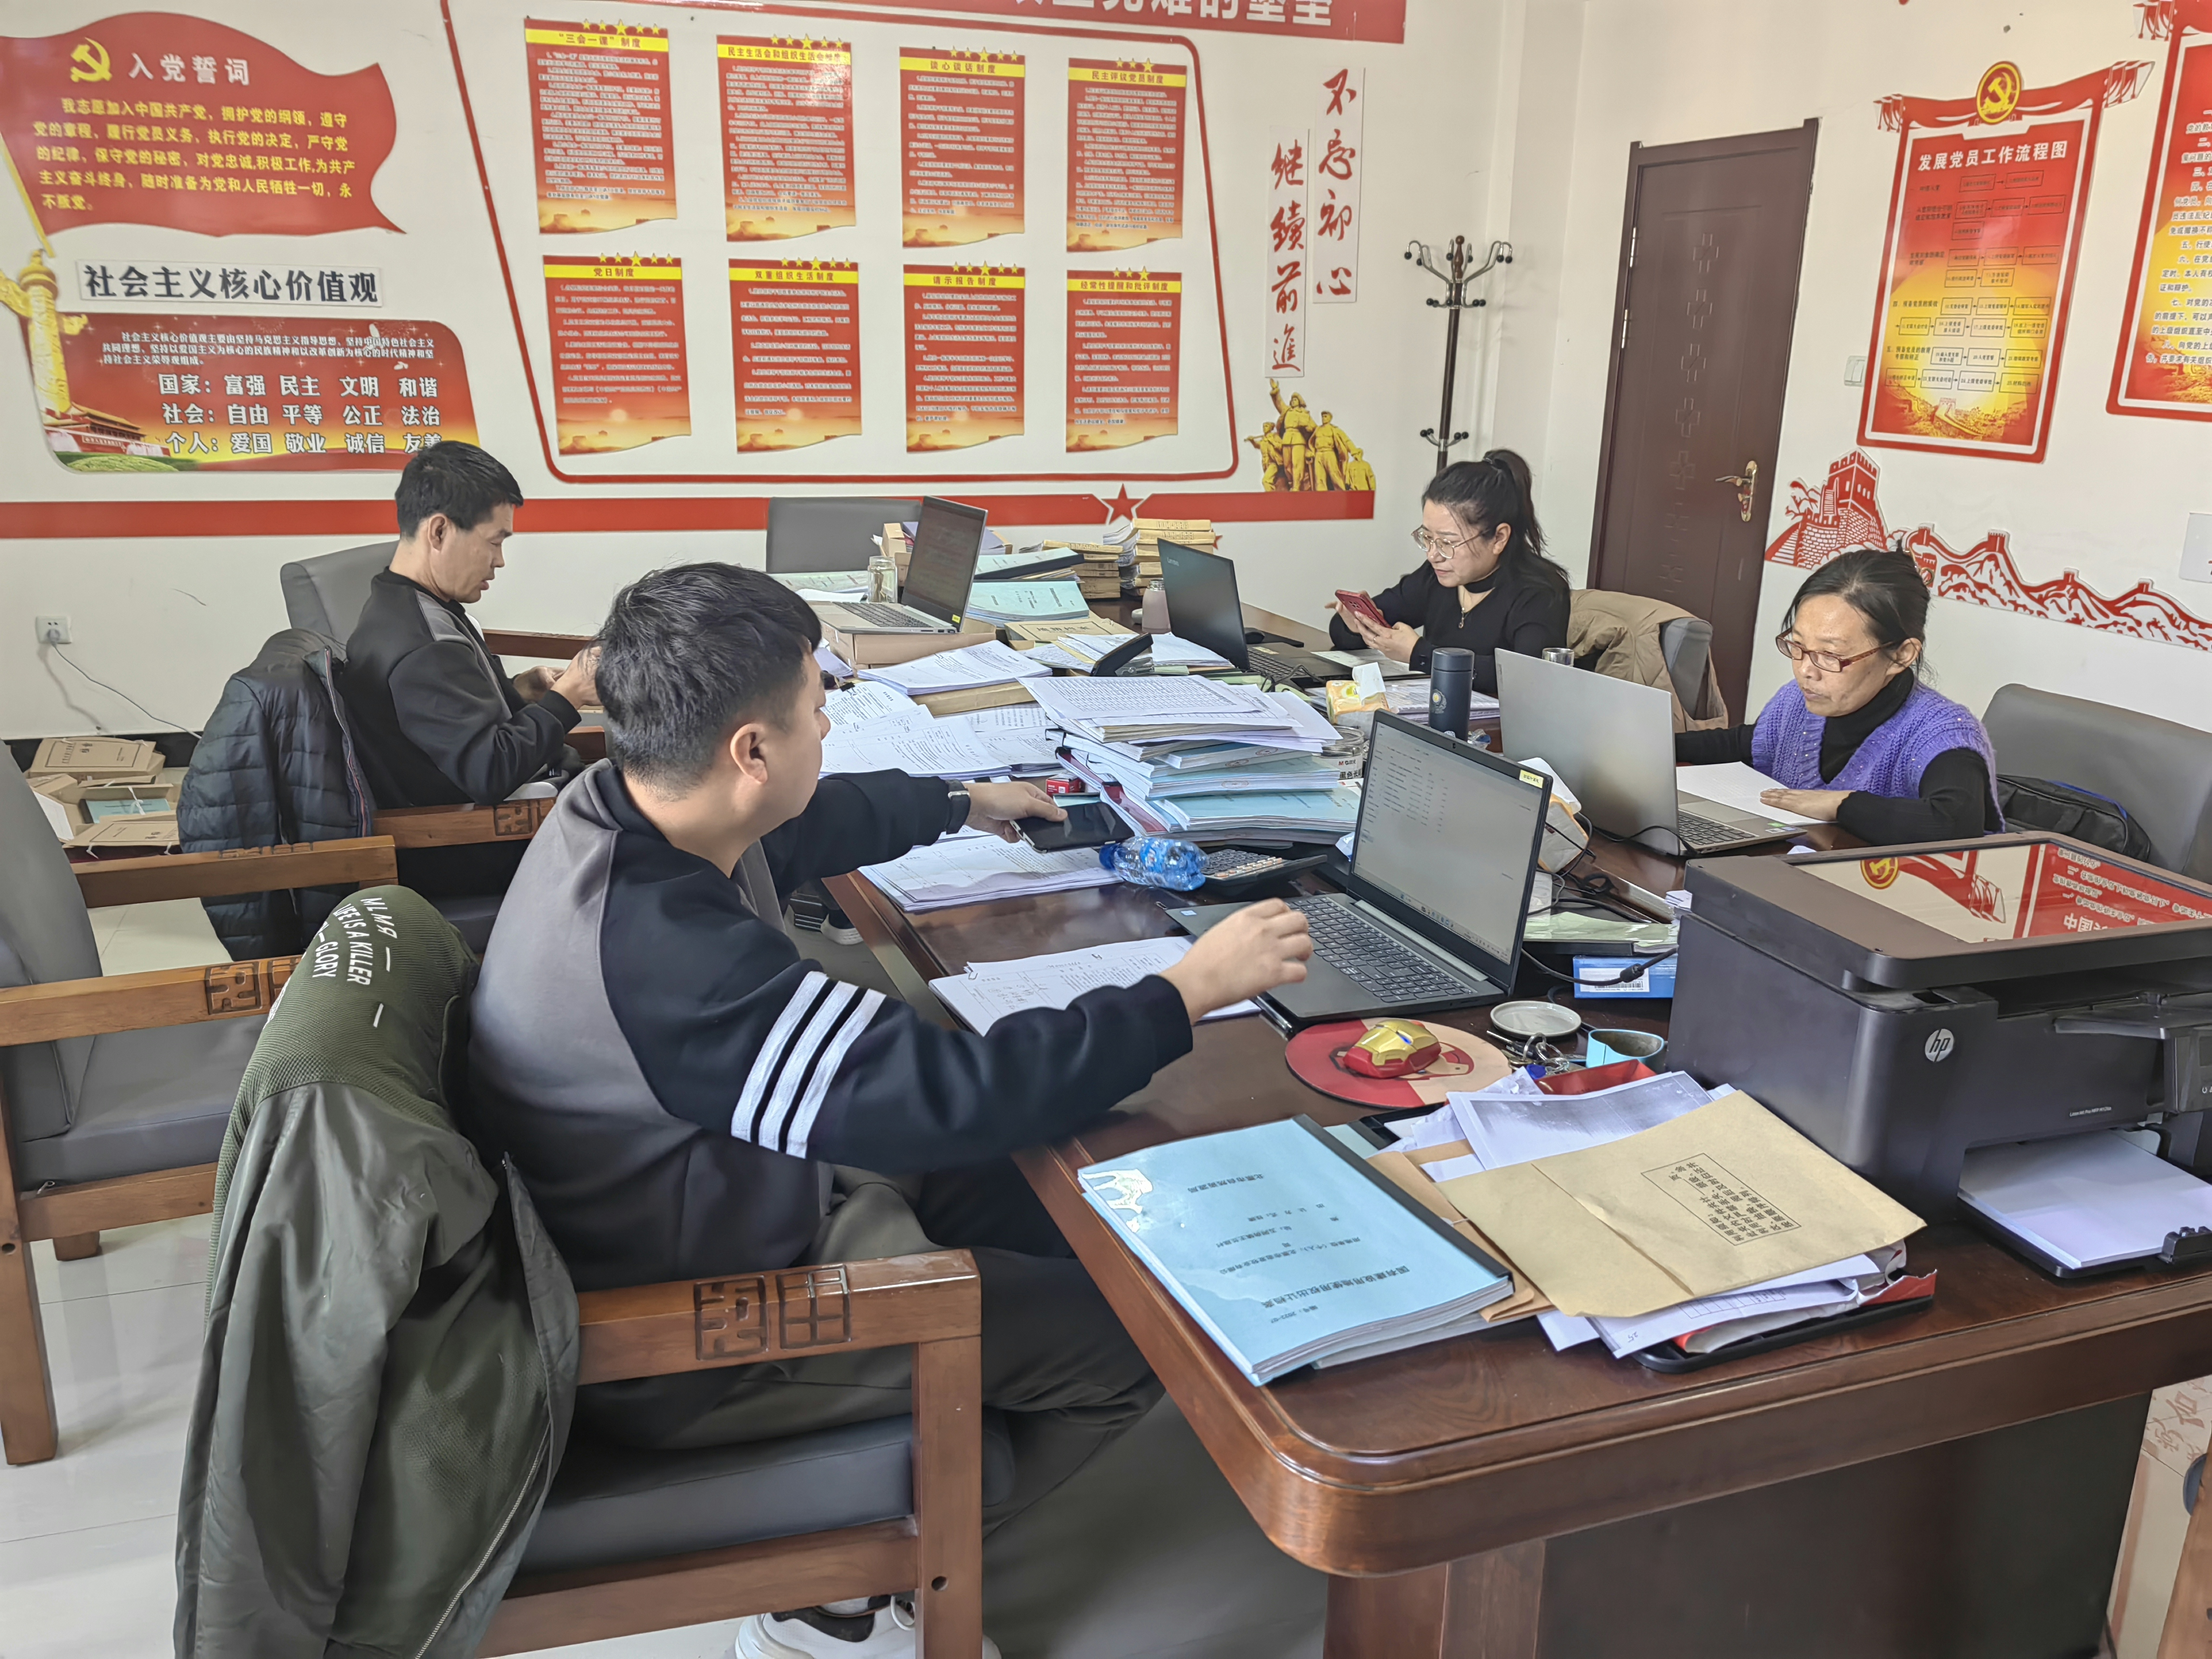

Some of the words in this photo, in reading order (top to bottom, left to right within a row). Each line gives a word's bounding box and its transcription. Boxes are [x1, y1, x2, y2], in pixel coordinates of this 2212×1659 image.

[129, 52, 251, 85] 入党誓词
[930, 60, 997, 75] 谈心谈话制度
[1091, 70, 1165, 84] 民主评议党员制度
[1918, 140, 2068, 172] 发展党员工作流程图
[84, 265, 380, 303] 社会主义核心价值观
[594, 267, 635, 278] 党日制度
[755, 270, 835, 282] 双重组织生活制度
[933, 275, 998, 287] 请示报告制度
[1081, 281, 1168, 291] 经常性提醒和批评制度
[158, 373, 212, 396] 国家：
[223, 374, 266, 397] 富强
[280, 375, 321, 398] 民主
[339, 376, 380, 399] 文明
[399, 376, 439, 399] 和谐
[161, 401, 215, 425] 社会：
[227, 402, 269, 427] 自由
[282, 402, 323, 427] 平等
[342, 403, 383, 427] 公正
[401, 403, 441, 427] 法治
[165, 431, 219, 455] 个人：
[231, 432, 272, 455] 爱国
[285, 433, 327, 455] 敬业
[345, 433, 386, 455] 诚信
[342, 919, 367, 928] IS
[312, 941, 339, 977] GLORY
[347, 942, 373, 985] KILLER
[1261, 1265, 1410, 1310] 国有建设用地使用权出让档案
